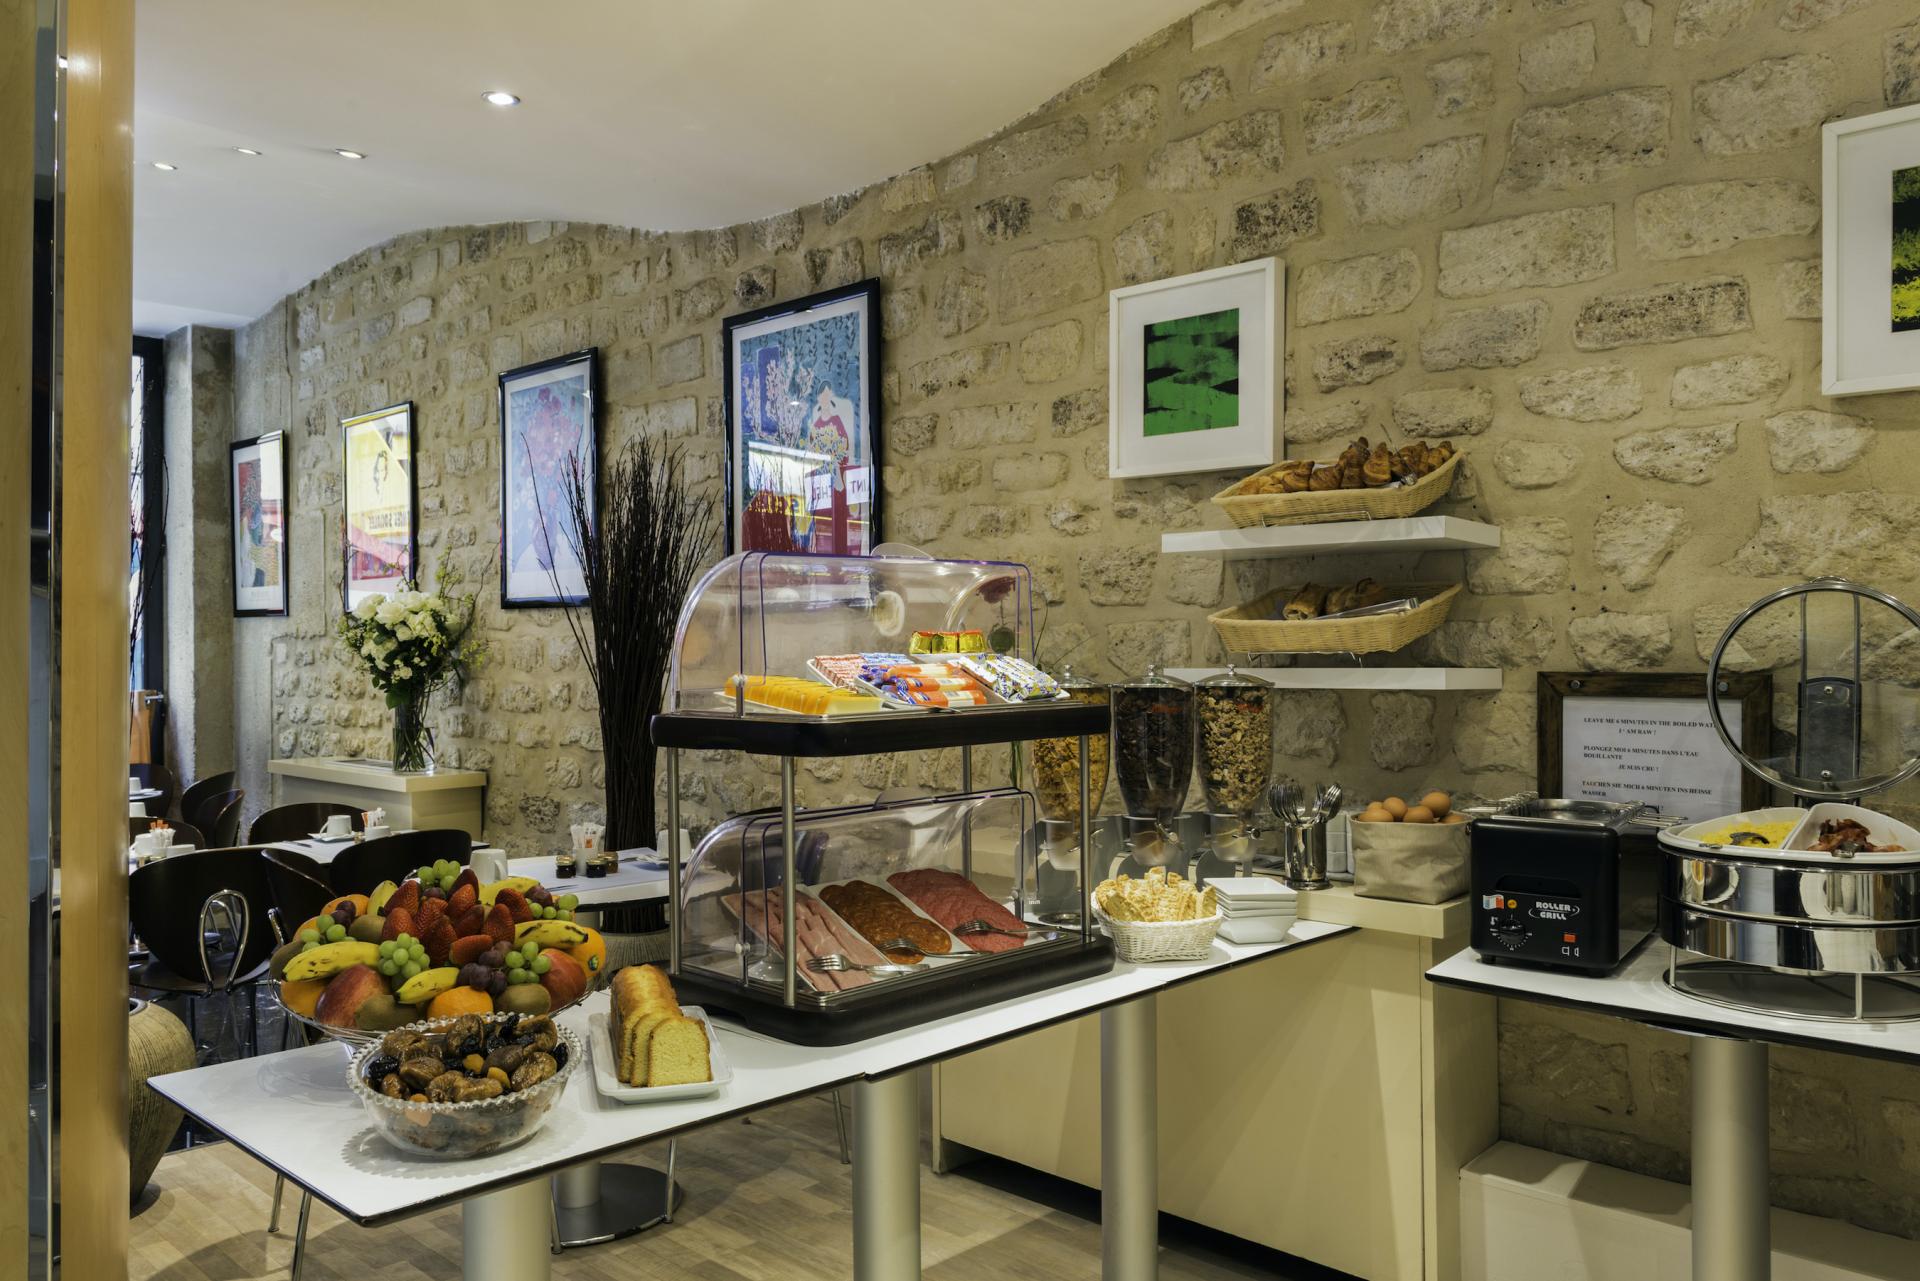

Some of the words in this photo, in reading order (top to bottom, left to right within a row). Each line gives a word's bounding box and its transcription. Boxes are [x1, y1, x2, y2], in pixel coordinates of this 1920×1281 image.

[1582, 780, 1611, 788] TAUCHEN
[1646, 784, 1676, 792] MINUTEN
[1536, 901, 1571, 912] ROLLER
[1540, 911, 1567, 921] GRILL
